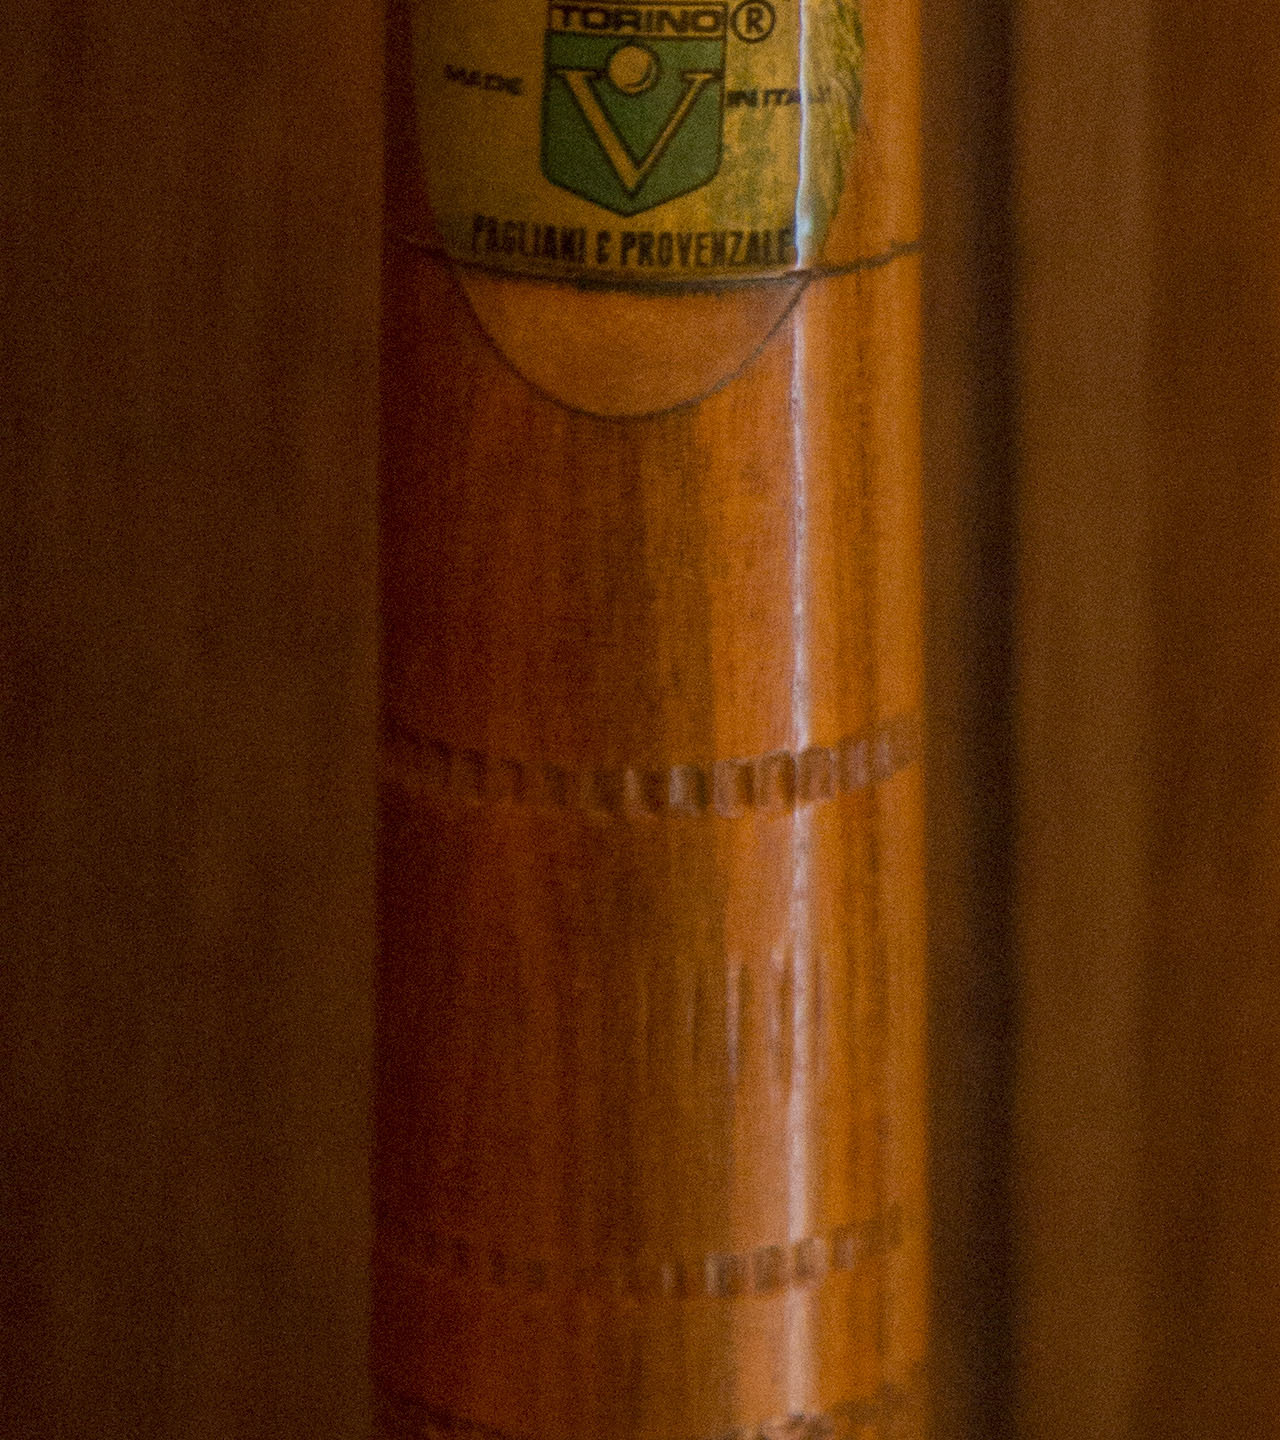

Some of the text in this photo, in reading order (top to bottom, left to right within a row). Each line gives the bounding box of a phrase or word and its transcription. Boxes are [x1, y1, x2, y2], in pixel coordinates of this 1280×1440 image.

[556, 6, 723, 34] TORINO
[443, 63, 522, 97] MADE
[727, 88, 758, 108] IN
[471, 213, 587, 264] PAGLIANI
[620, 227, 794, 268] PROVENZALE
